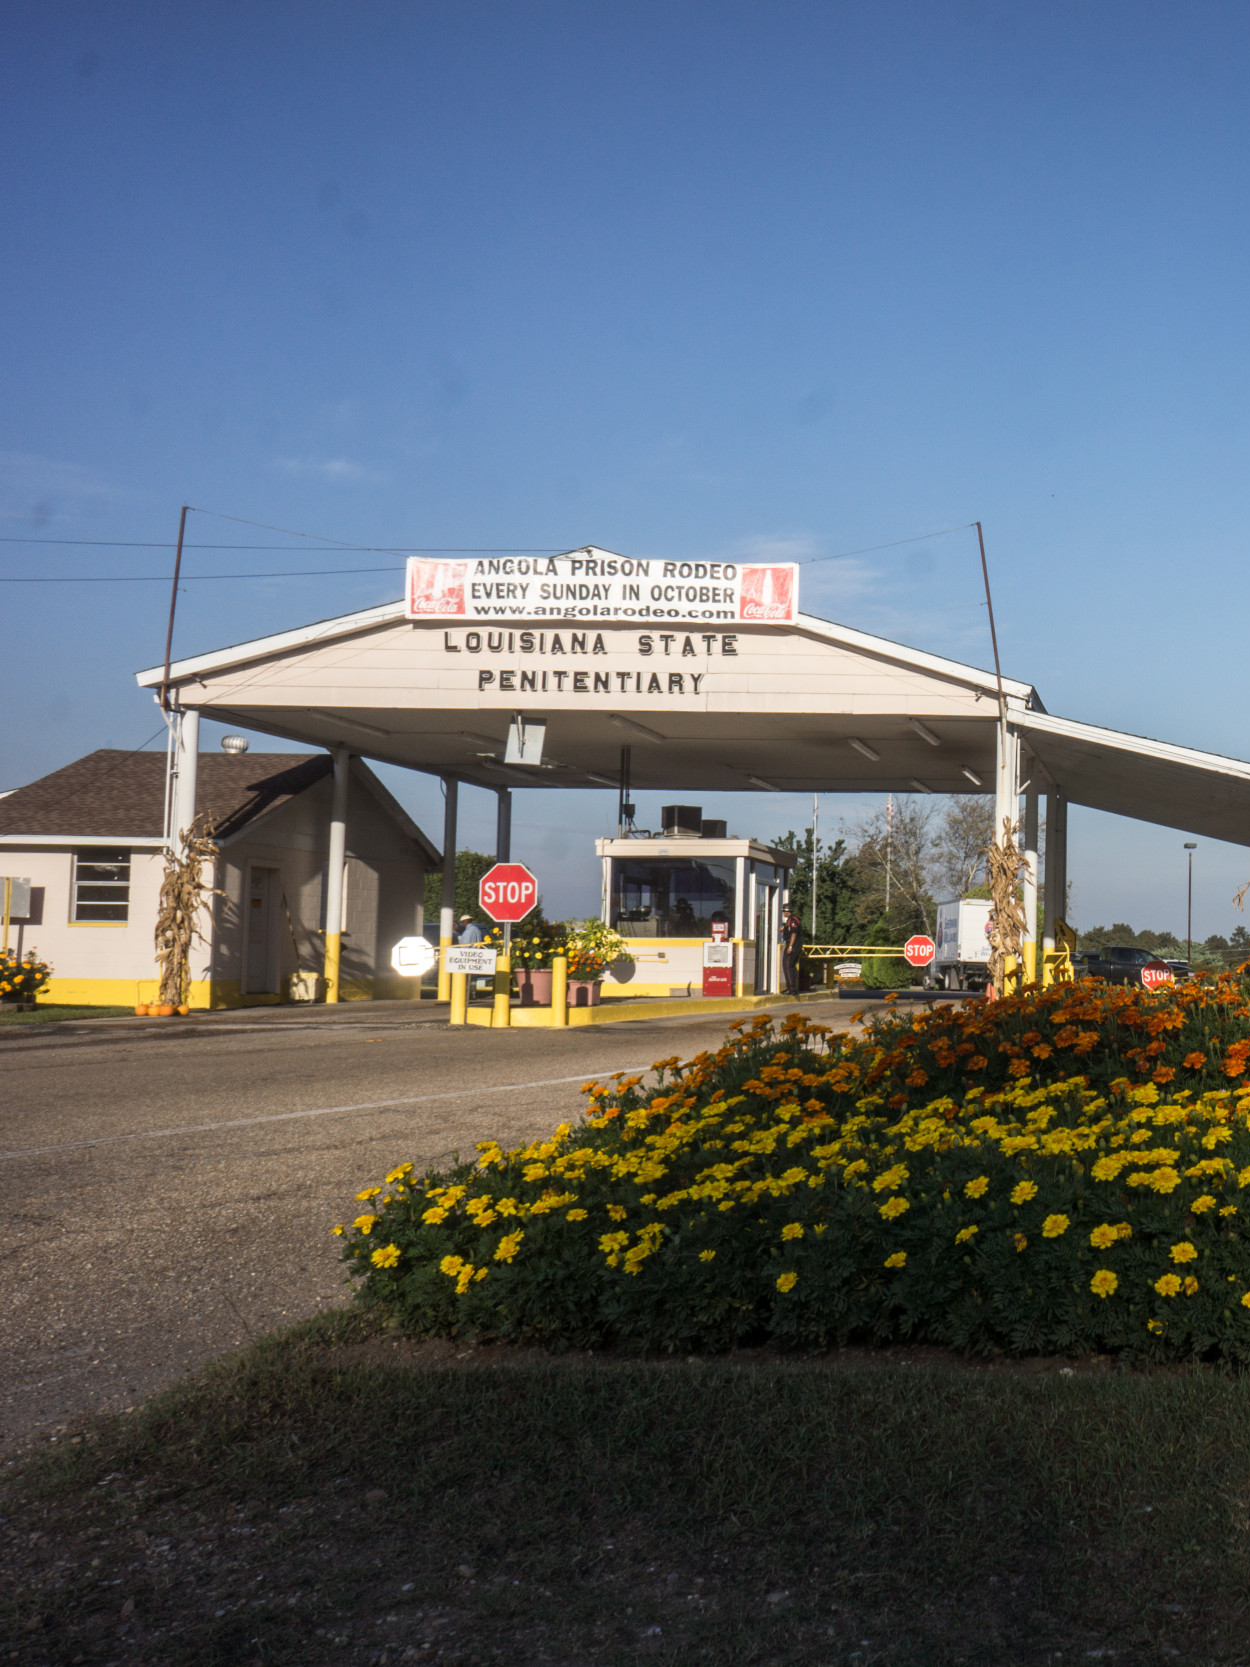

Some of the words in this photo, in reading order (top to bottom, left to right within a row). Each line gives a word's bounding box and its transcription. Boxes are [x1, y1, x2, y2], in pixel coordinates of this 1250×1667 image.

[474, 558, 559, 576] ANGOLA
[571, 559, 650, 577] PRISON
[662, 562, 737, 580] RODEO
[471, 582, 530, 599] EVERY
[539, 583, 611, 600] SUNDAY
[622, 584, 640, 601] IN
[650, 585, 735, 603] OCTOBER
[473, 604, 736, 620] www.angolarodeo.com
[444, 631, 607, 654] LOUISIANA
[638, 634, 738, 656] STATE
[478, 669, 704, 694] PENITENTIARY
[483, 881, 533, 903] STOP
[460, 950, 484, 958] VIDEO
[906, 944, 934, 957] STOP
[449, 957, 493, 965] EQUIPMENT
[1143, 969, 1170, 982] STOP
